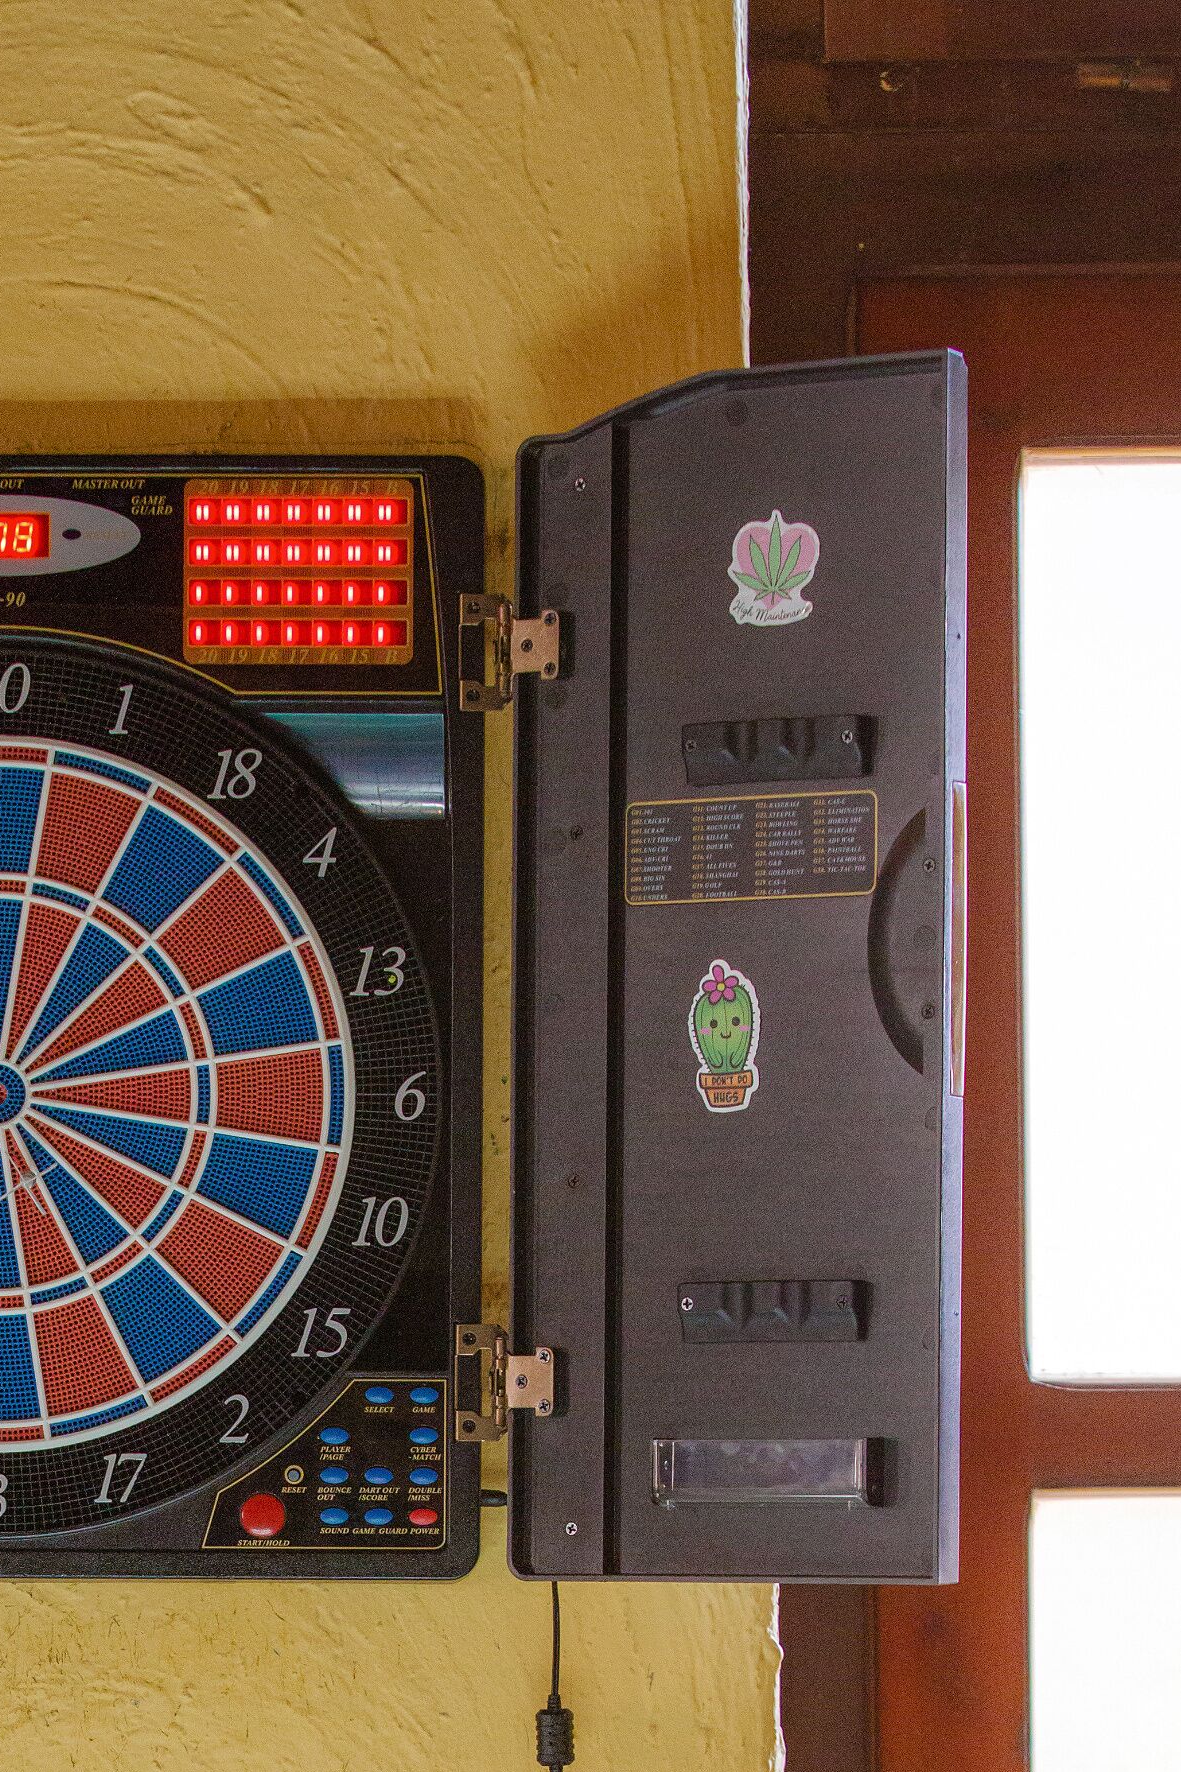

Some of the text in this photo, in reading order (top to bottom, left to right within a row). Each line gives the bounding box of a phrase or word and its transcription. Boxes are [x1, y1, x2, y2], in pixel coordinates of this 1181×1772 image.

[0, 479, 25, 490] OUT
[72, 479, 145, 490] MASTER OUT
[132, 496, 166, 506] GAME
[132, 505, 173, 516] GUARD
[733, 599, 805, 621] High Maintenan
[109, 684, 134, 735] 1
[207, 749, 262, 800] 18
[303, 827, 337, 877] 4
[349, 946, 406, 996] 13
[394, 1071, 426, 1121] 6
[704, 1075, 748, 1086] I DON'T DO
[713, 1092, 738, 1103] HUGS
[351, 1197, 409, 1246] 10
[291, 1307, 351, 1358] 15
[219, 1394, 250, 1444] 2
[93, 1453, 147, 1503] 17
[319, 1453, 344, 1461] /PAGE
